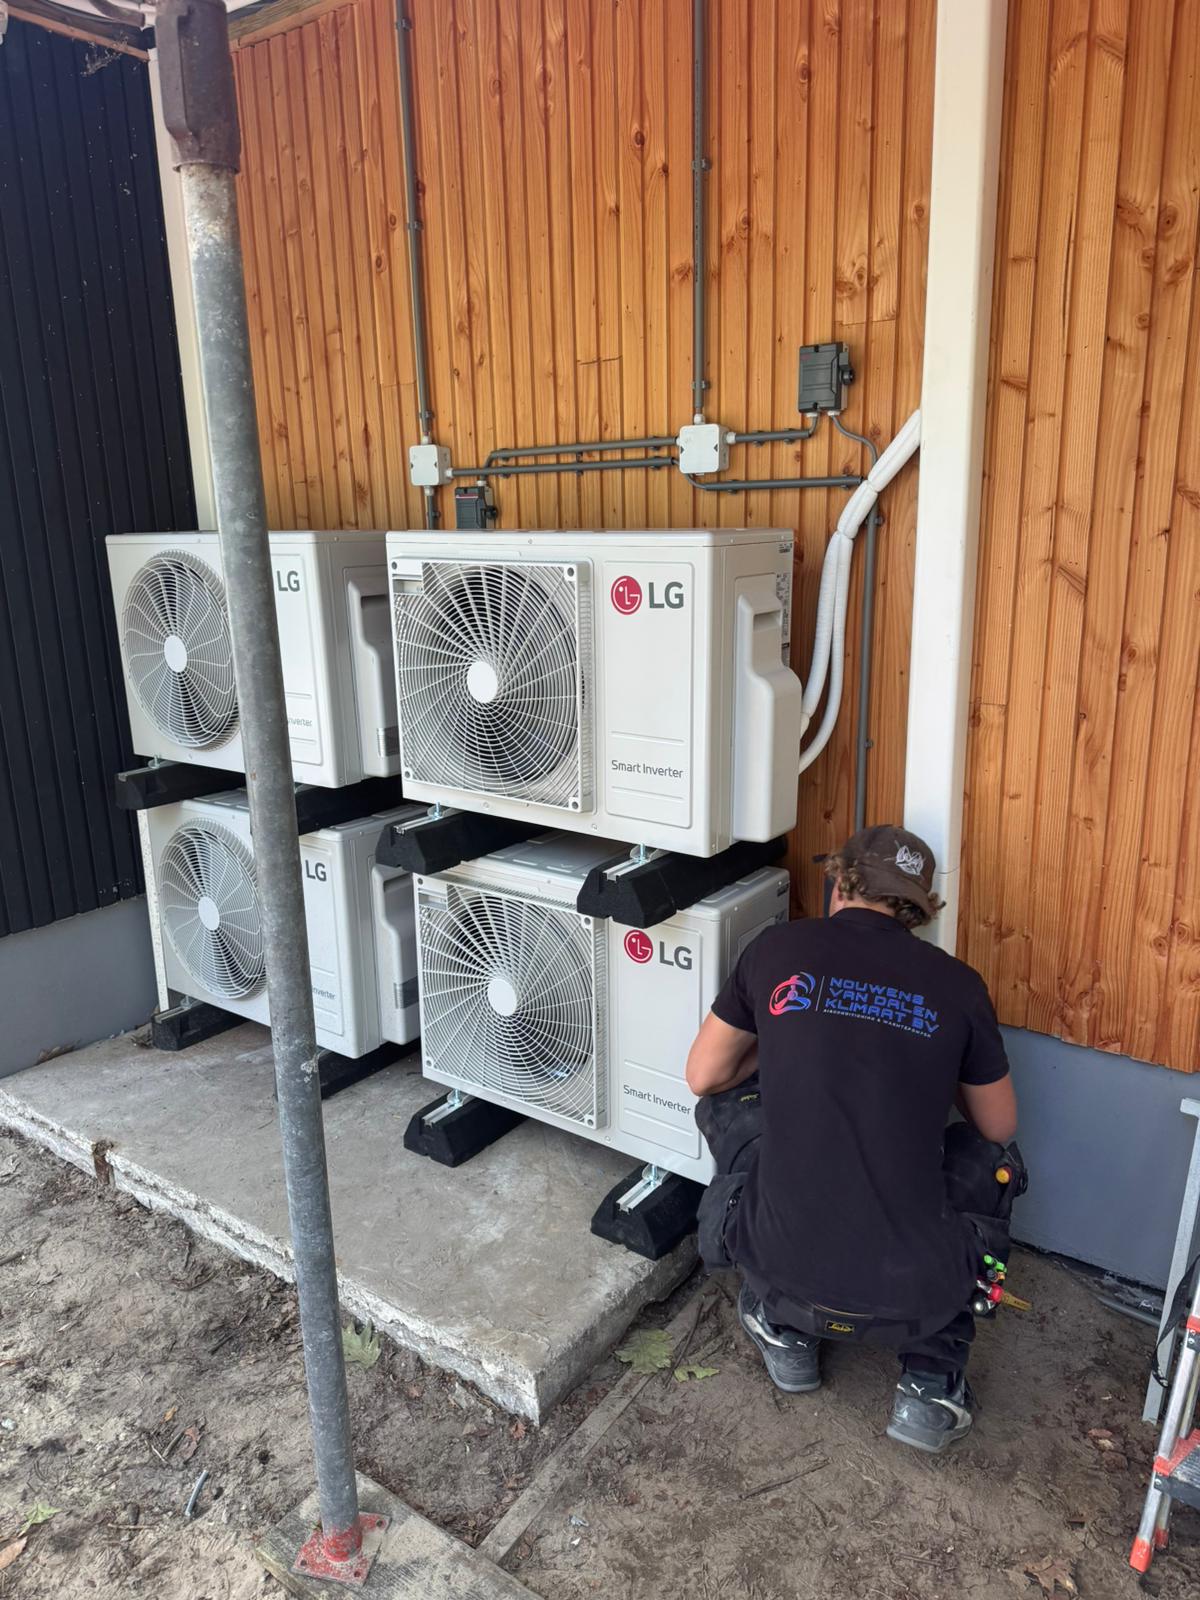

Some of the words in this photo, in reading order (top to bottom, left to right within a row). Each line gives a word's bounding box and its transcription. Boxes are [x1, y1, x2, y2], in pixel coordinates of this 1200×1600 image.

[276, 570, 301, 592] LG
[648, 581, 684, 609] LG
[611, 759, 641, 774] Smart
[643, 763, 684, 778] Inverter
[305, 859, 327, 882] LG
[659, 940, 693, 971] LG
[829, 976, 925, 1006] NOUWENS
[829, 987, 869, 1003] VAN
[873, 995, 938, 1022] DALEN
[824, 997, 907, 1023] KLIMAAT
[911, 1016, 940, 1033] BV
[623, 1084, 652, 1102] Smart
[652, 1094, 691, 1115] Inverter
